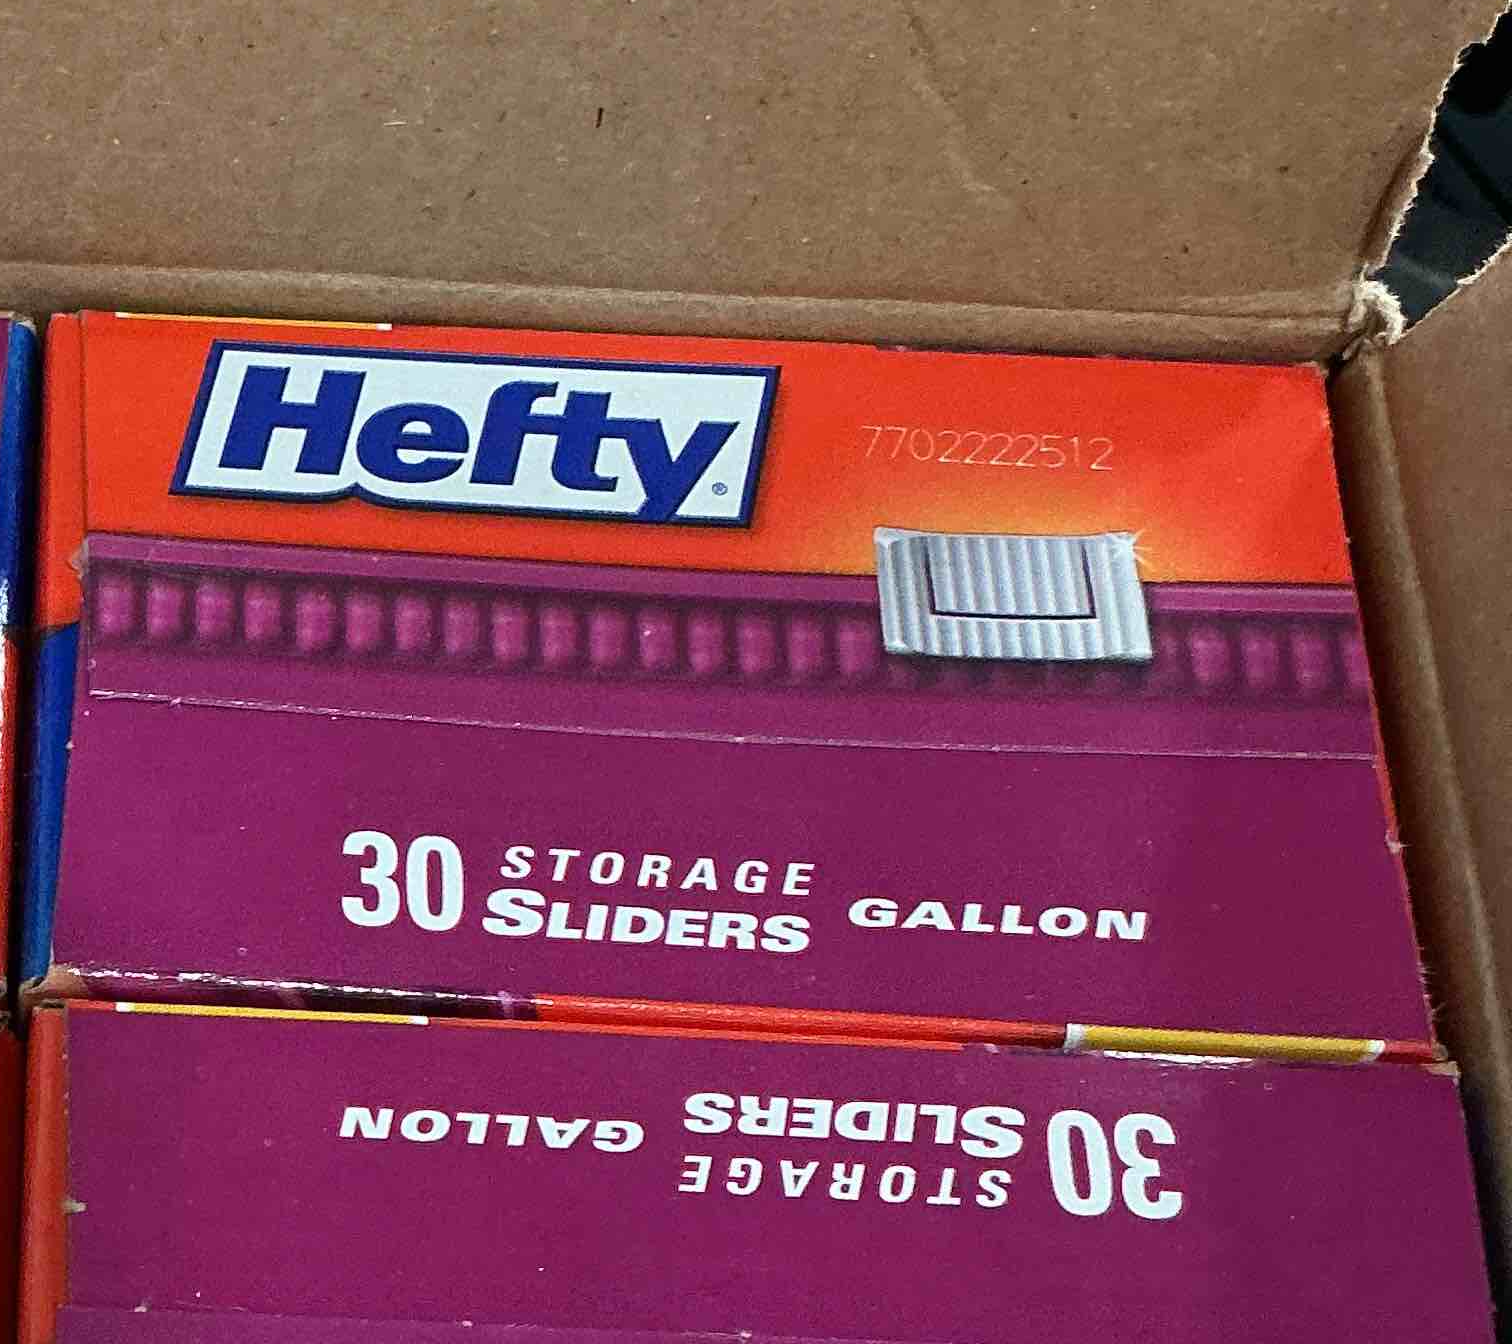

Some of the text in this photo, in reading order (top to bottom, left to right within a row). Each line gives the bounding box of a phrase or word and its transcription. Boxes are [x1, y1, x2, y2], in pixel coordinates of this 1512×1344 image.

[220, 366, 737, 522] Hefty
[861, 425, 1114, 471] 7702222512
[342, 831, 464, 931] 30
[501, 846, 814, 895] STORAGE
[482, 889, 1147, 952] SLIDERS GALLON
[340, 1093, 1025, 1158] SLIDERS GALLON
[678, 1156, 1011, 1207] STORAGE
[1047, 1110, 1182, 1219] 30
